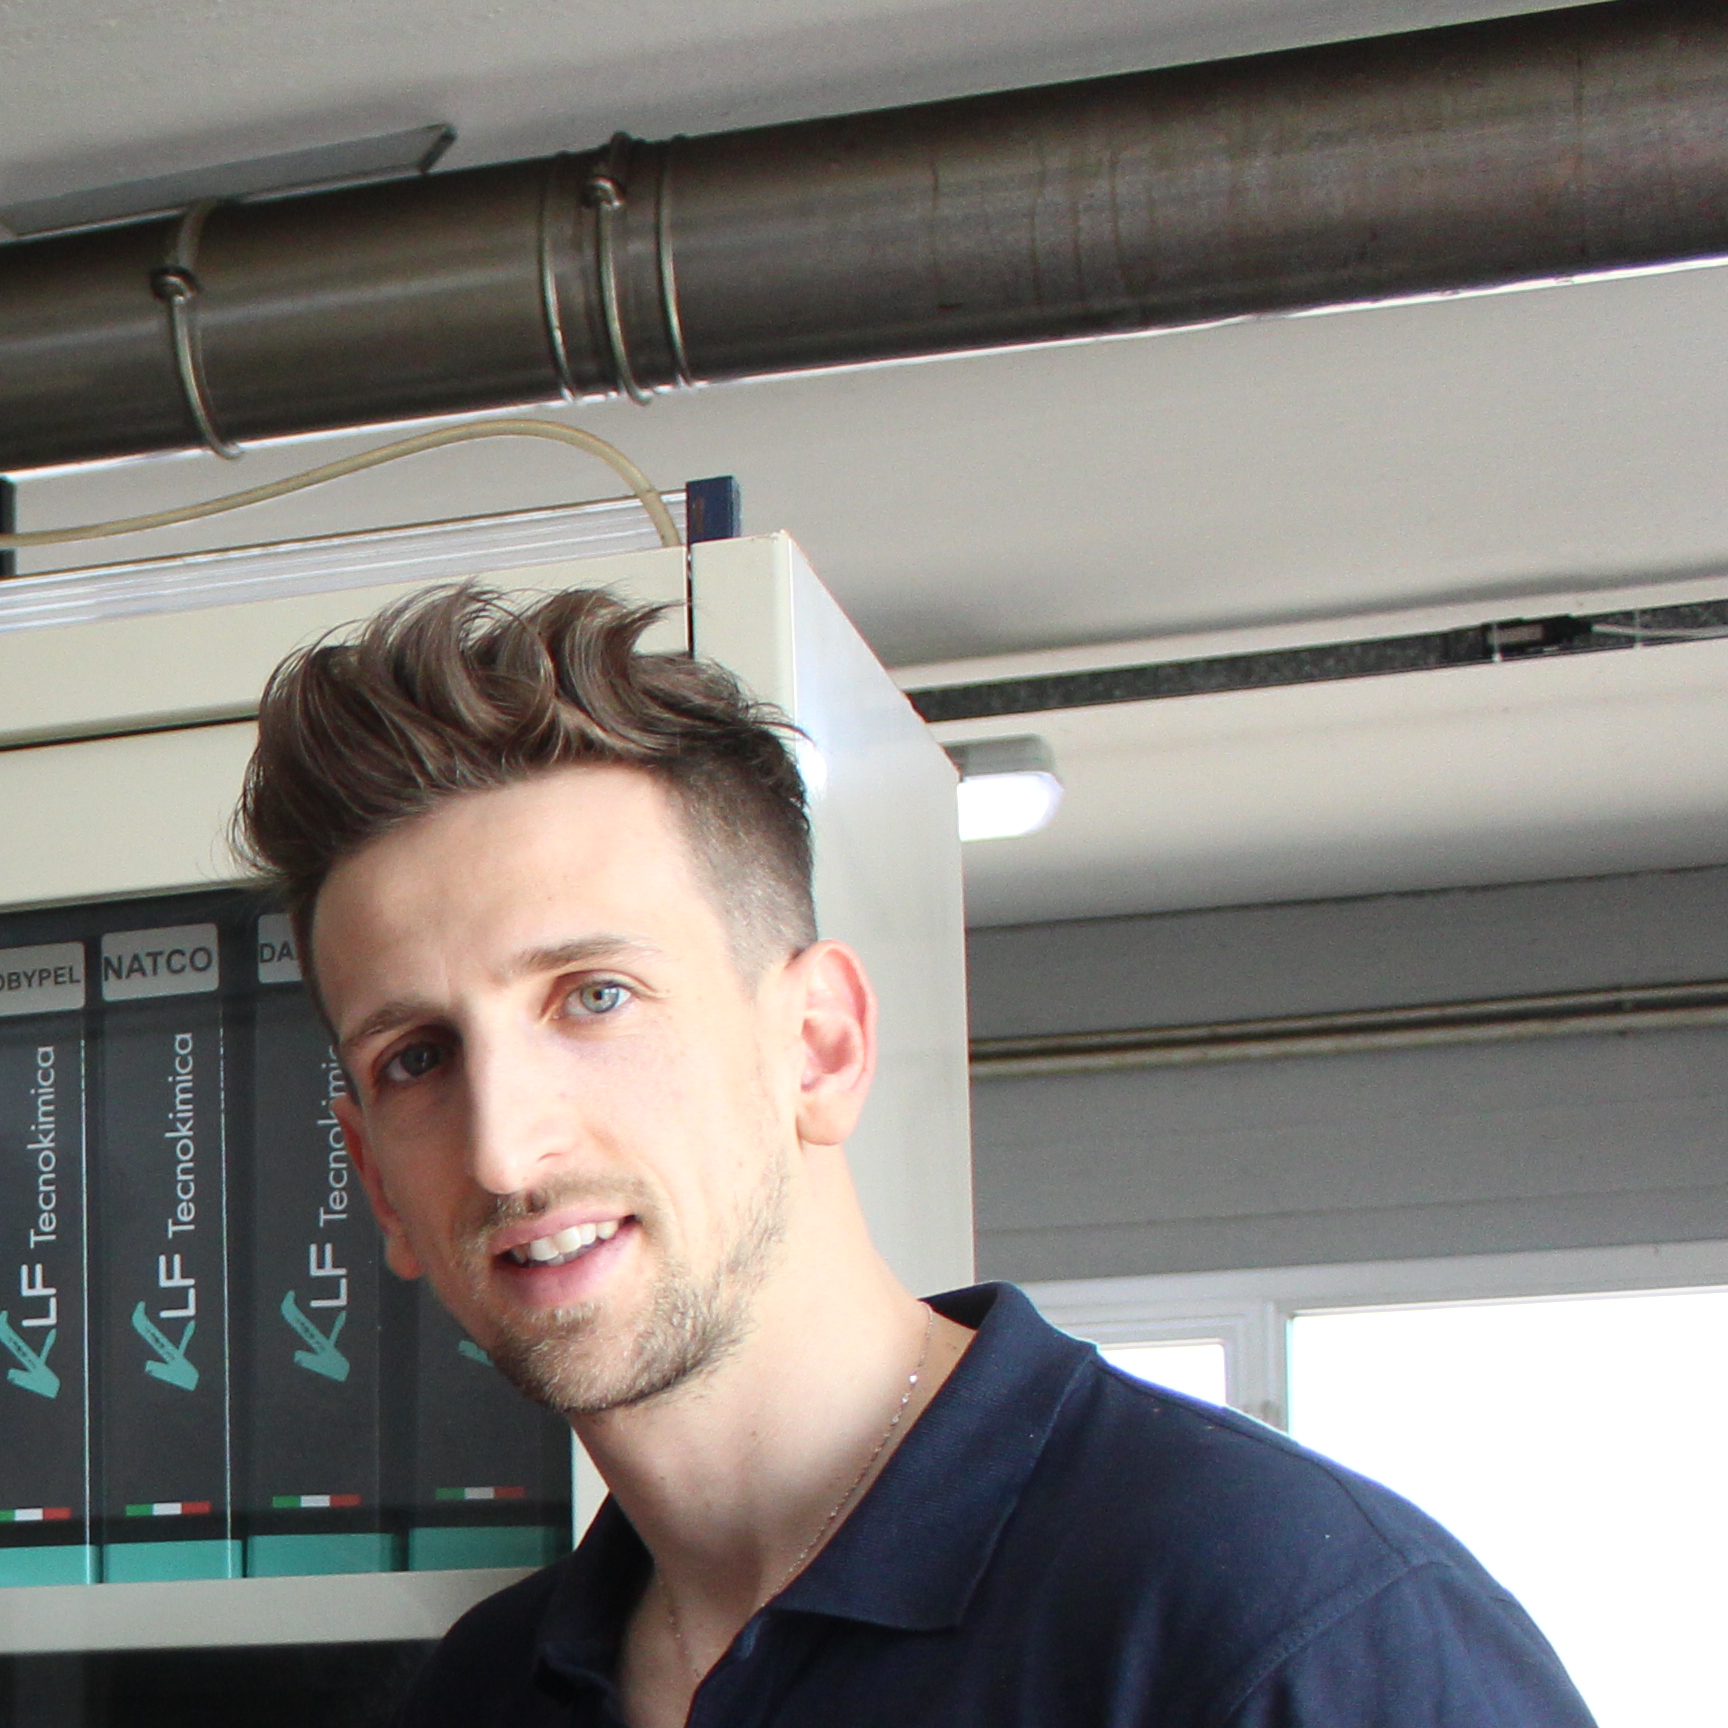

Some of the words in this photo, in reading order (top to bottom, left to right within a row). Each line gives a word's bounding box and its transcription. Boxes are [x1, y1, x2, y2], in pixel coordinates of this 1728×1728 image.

[102, 947, 213, 983] NATCO
[259, 941, 295, 964] DA
[27, 1044, 57, 1249] Tecnokimica
[164, 1031, 195, 1239] Tecnokimica
[20, 1262, 58, 1329] LF
[159, 1252, 197, 1320] LF
[309, 1242, 349, 1309] LF
